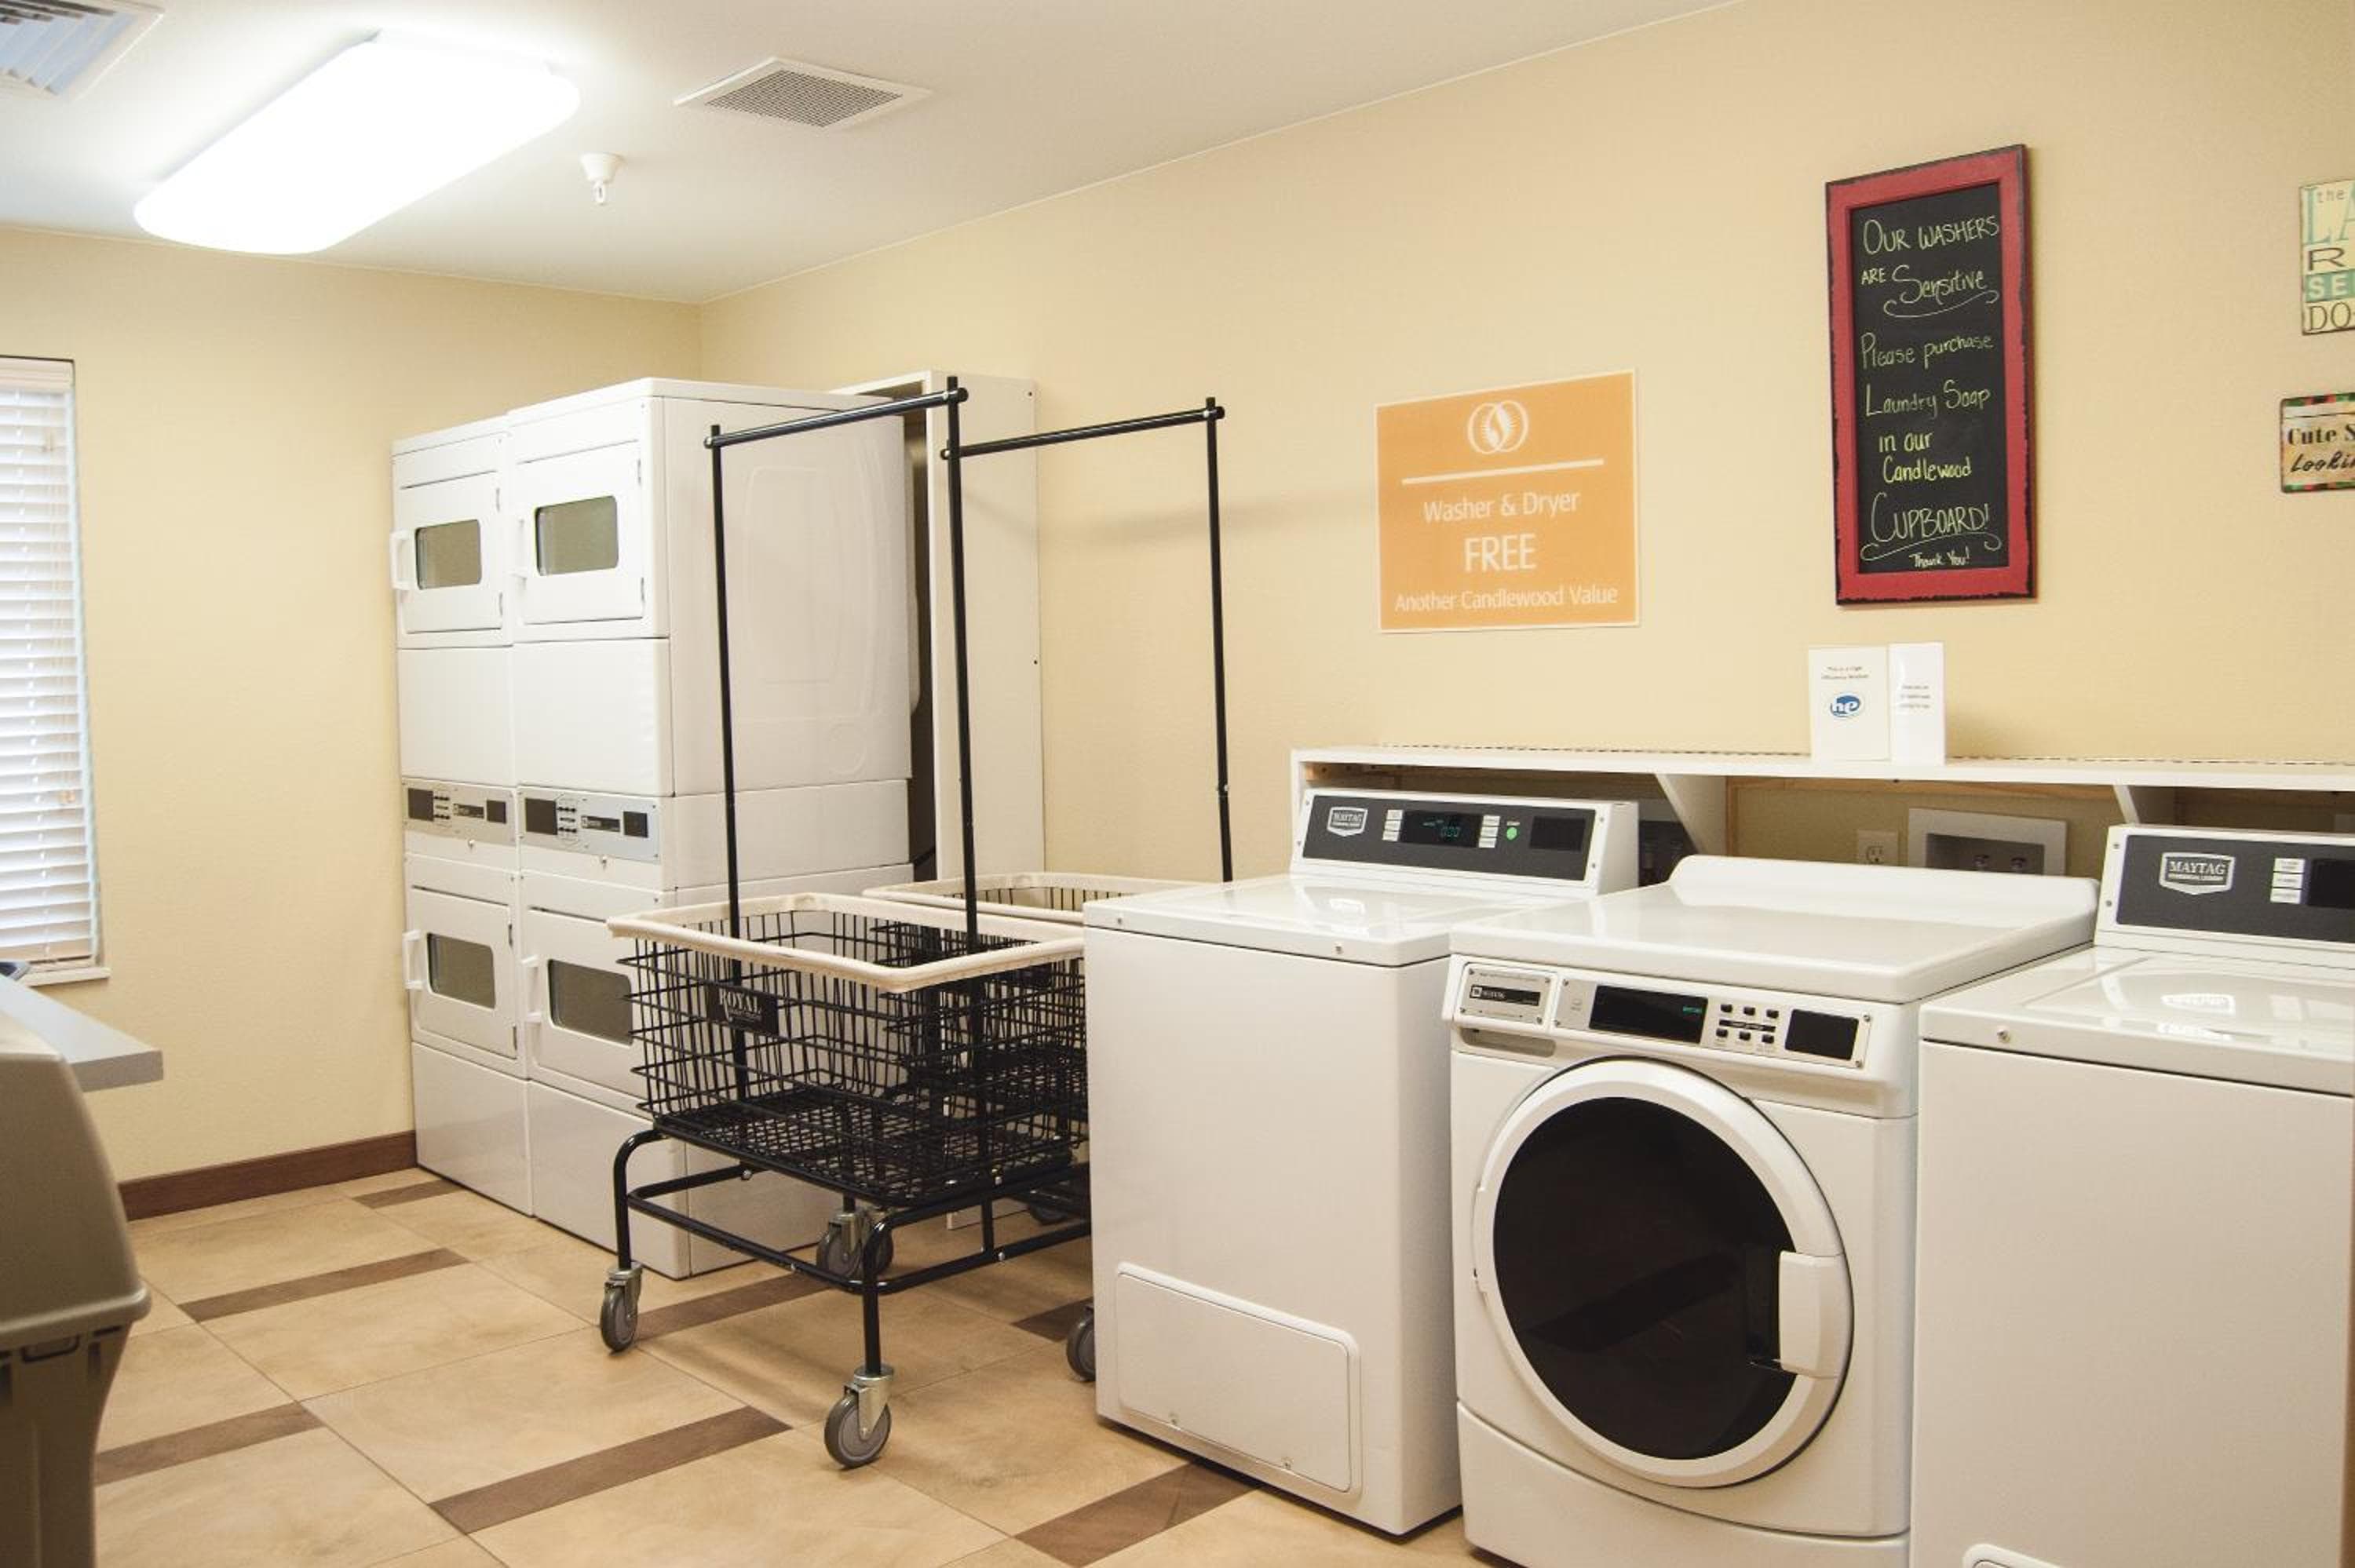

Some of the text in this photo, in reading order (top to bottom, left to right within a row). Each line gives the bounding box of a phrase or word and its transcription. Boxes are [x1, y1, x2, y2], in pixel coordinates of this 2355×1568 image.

[1864, 215, 1999, 255] OUR WASHERS
[1861, 264, 1988, 305] ARE Sensitive
[1861, 332, 1994, 370] Please purchase
[1866, 379, 1991, 420] Laundry Soap
[1904, 432, 1933, 452] our
[2287, 428, 2337, 445] Cute
[1883, 454, 1973, 483] Candlewood
[1423, 491, 1581, 523] Washer & Dryer
[1871, 491, 1990, 543] CUPBOARD!
[1464, 533, 1538, 572] FREE
[1909, 545, 1970, 568] Thank You!
[1394, 584, 1619, 612] Another Candlewood Value
[2170, 861, 2225, 876] MAYTAG
